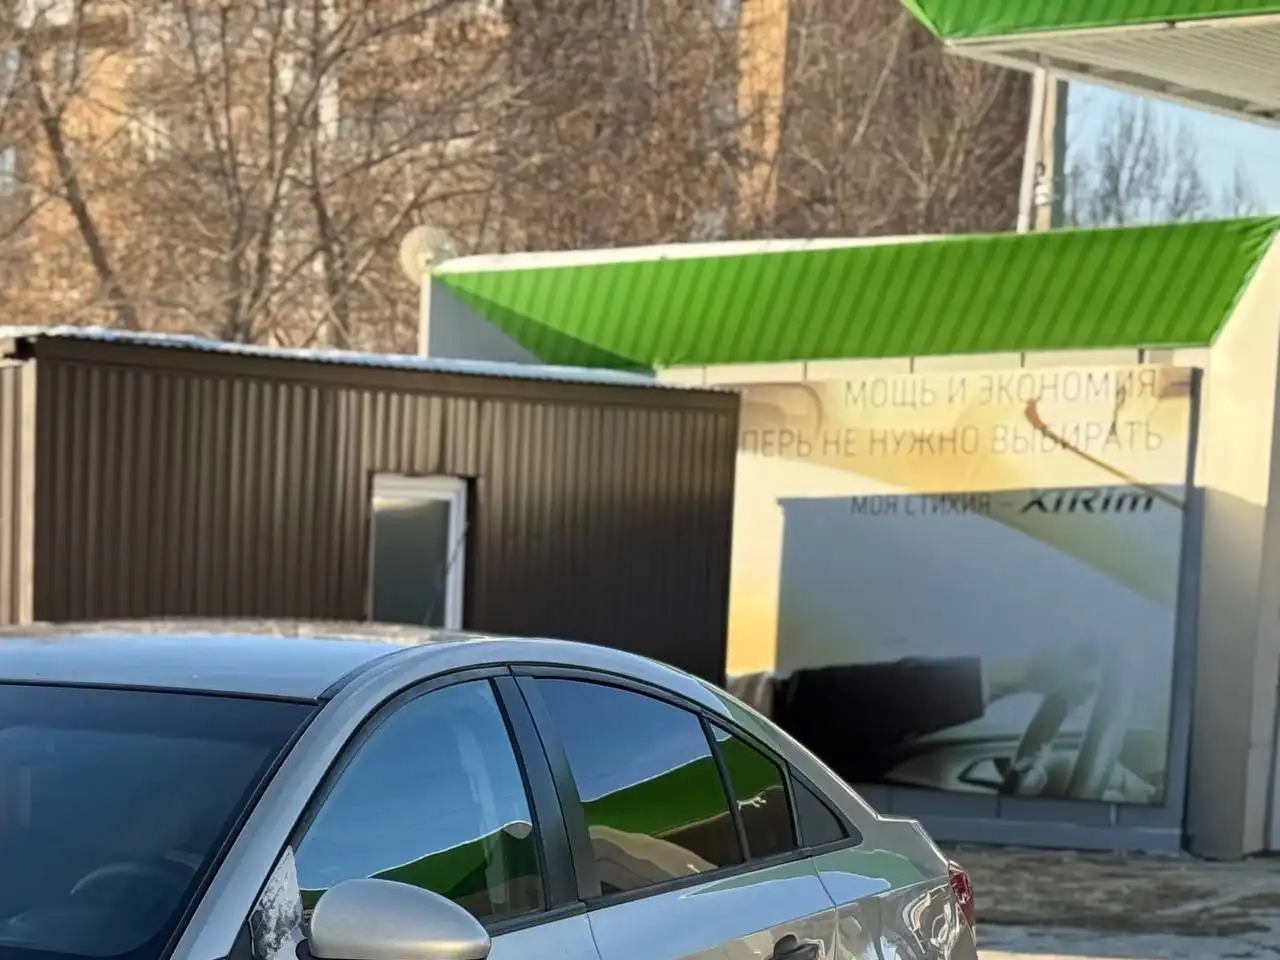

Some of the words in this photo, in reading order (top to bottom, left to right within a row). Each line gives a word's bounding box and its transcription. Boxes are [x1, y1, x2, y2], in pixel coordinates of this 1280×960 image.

[844, 377, 937, 410] МОЩЬ
[947, 376, 967, 405] И
[979, 368, 1156, 405] ЭКОНОМИЯ
[822, 427, 857, 457] НЕ
[869, 425, 980, 456] НУЖНО
[990, 420, 1163, 454] ВЫБИРАТЬ
[850, 494, 898, 516] МОЯ
[904, 491, 992, 516] СТИХИЯ
